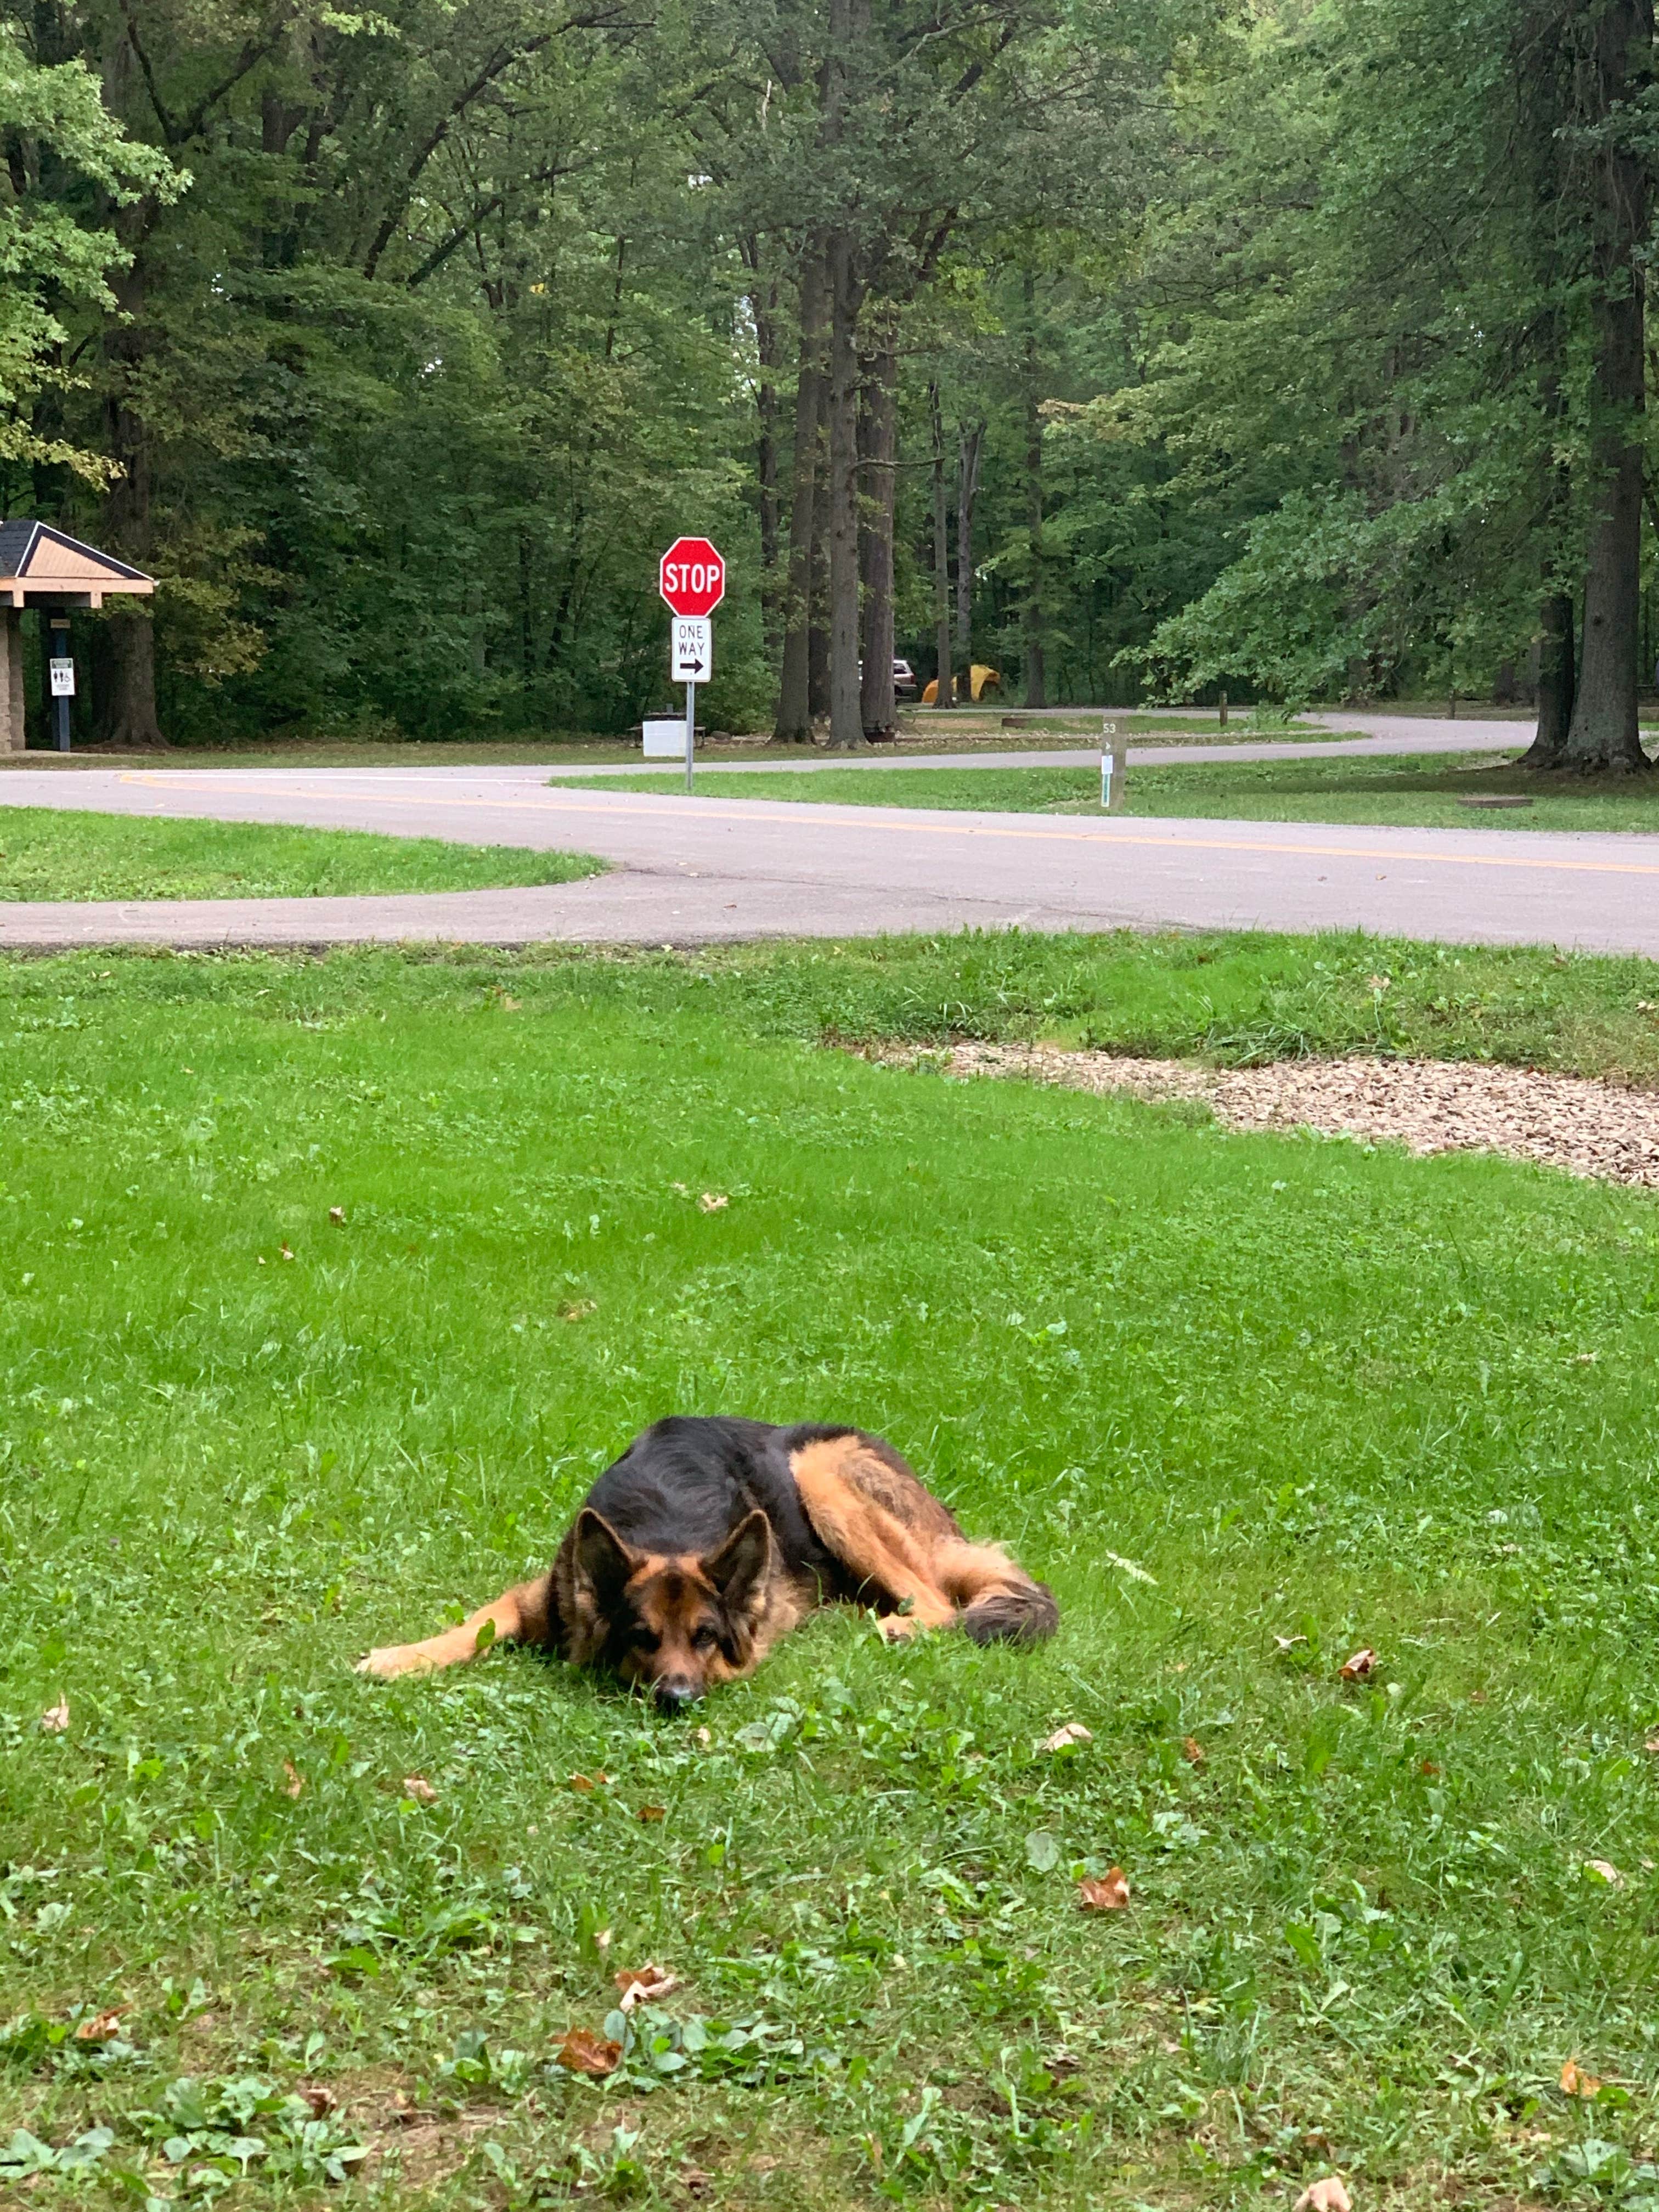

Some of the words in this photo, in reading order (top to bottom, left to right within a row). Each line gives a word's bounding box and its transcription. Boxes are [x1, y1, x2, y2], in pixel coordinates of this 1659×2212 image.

[664, 563, 720, 593] STOP
[679, 625, 703, 639] ONE
[678, 642, 705, 656] WAY
[1103, 723, 1116, 733] 53
